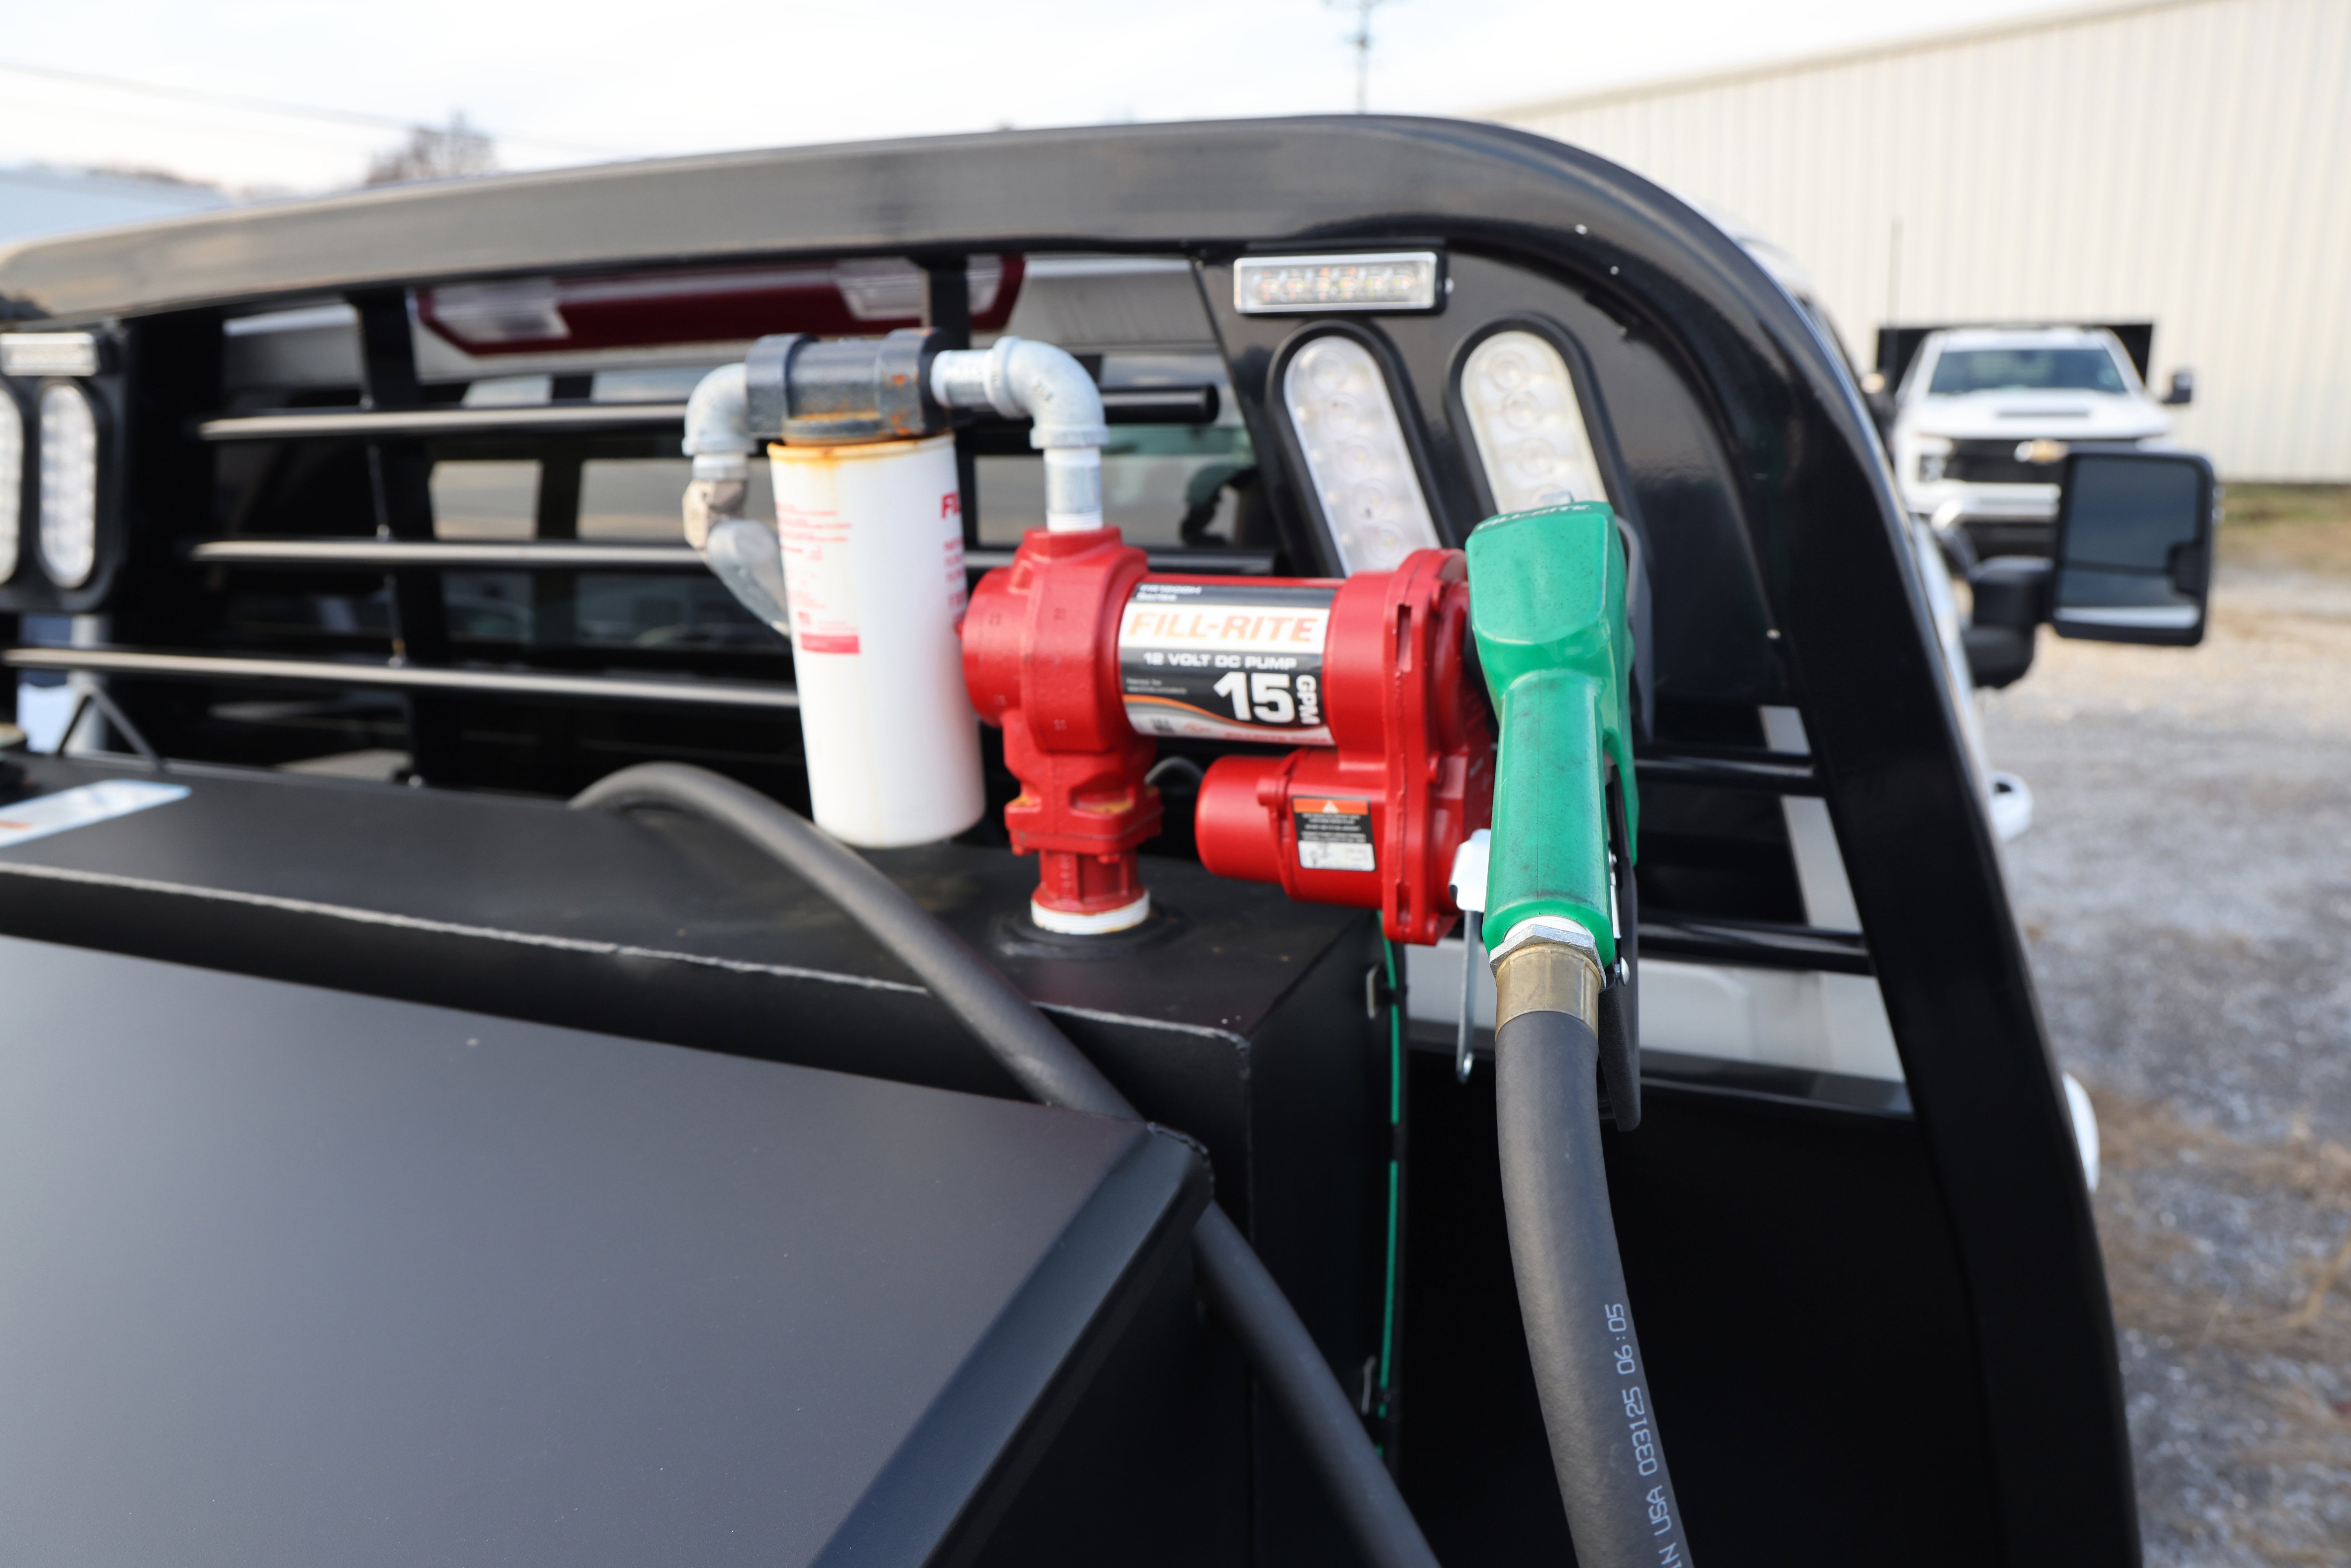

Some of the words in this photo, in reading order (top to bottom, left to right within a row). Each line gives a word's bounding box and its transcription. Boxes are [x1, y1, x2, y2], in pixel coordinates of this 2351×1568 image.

[1128, 612, 1318, 642] FILL-RITE
[1144, 652, 1164, 665] 12
[1167, 653, 1211, 667] VOLT
[1214, 655, 1241, 669] DC
[1244, 657, 1297, 670] PUMP
[1213, 671, 1295, 724] 15
[1295, 674, 1321, 725] GPM
[1622, 1386, 1658, 1476] 033125
[1646, 1486, 1672, 1536] USA
